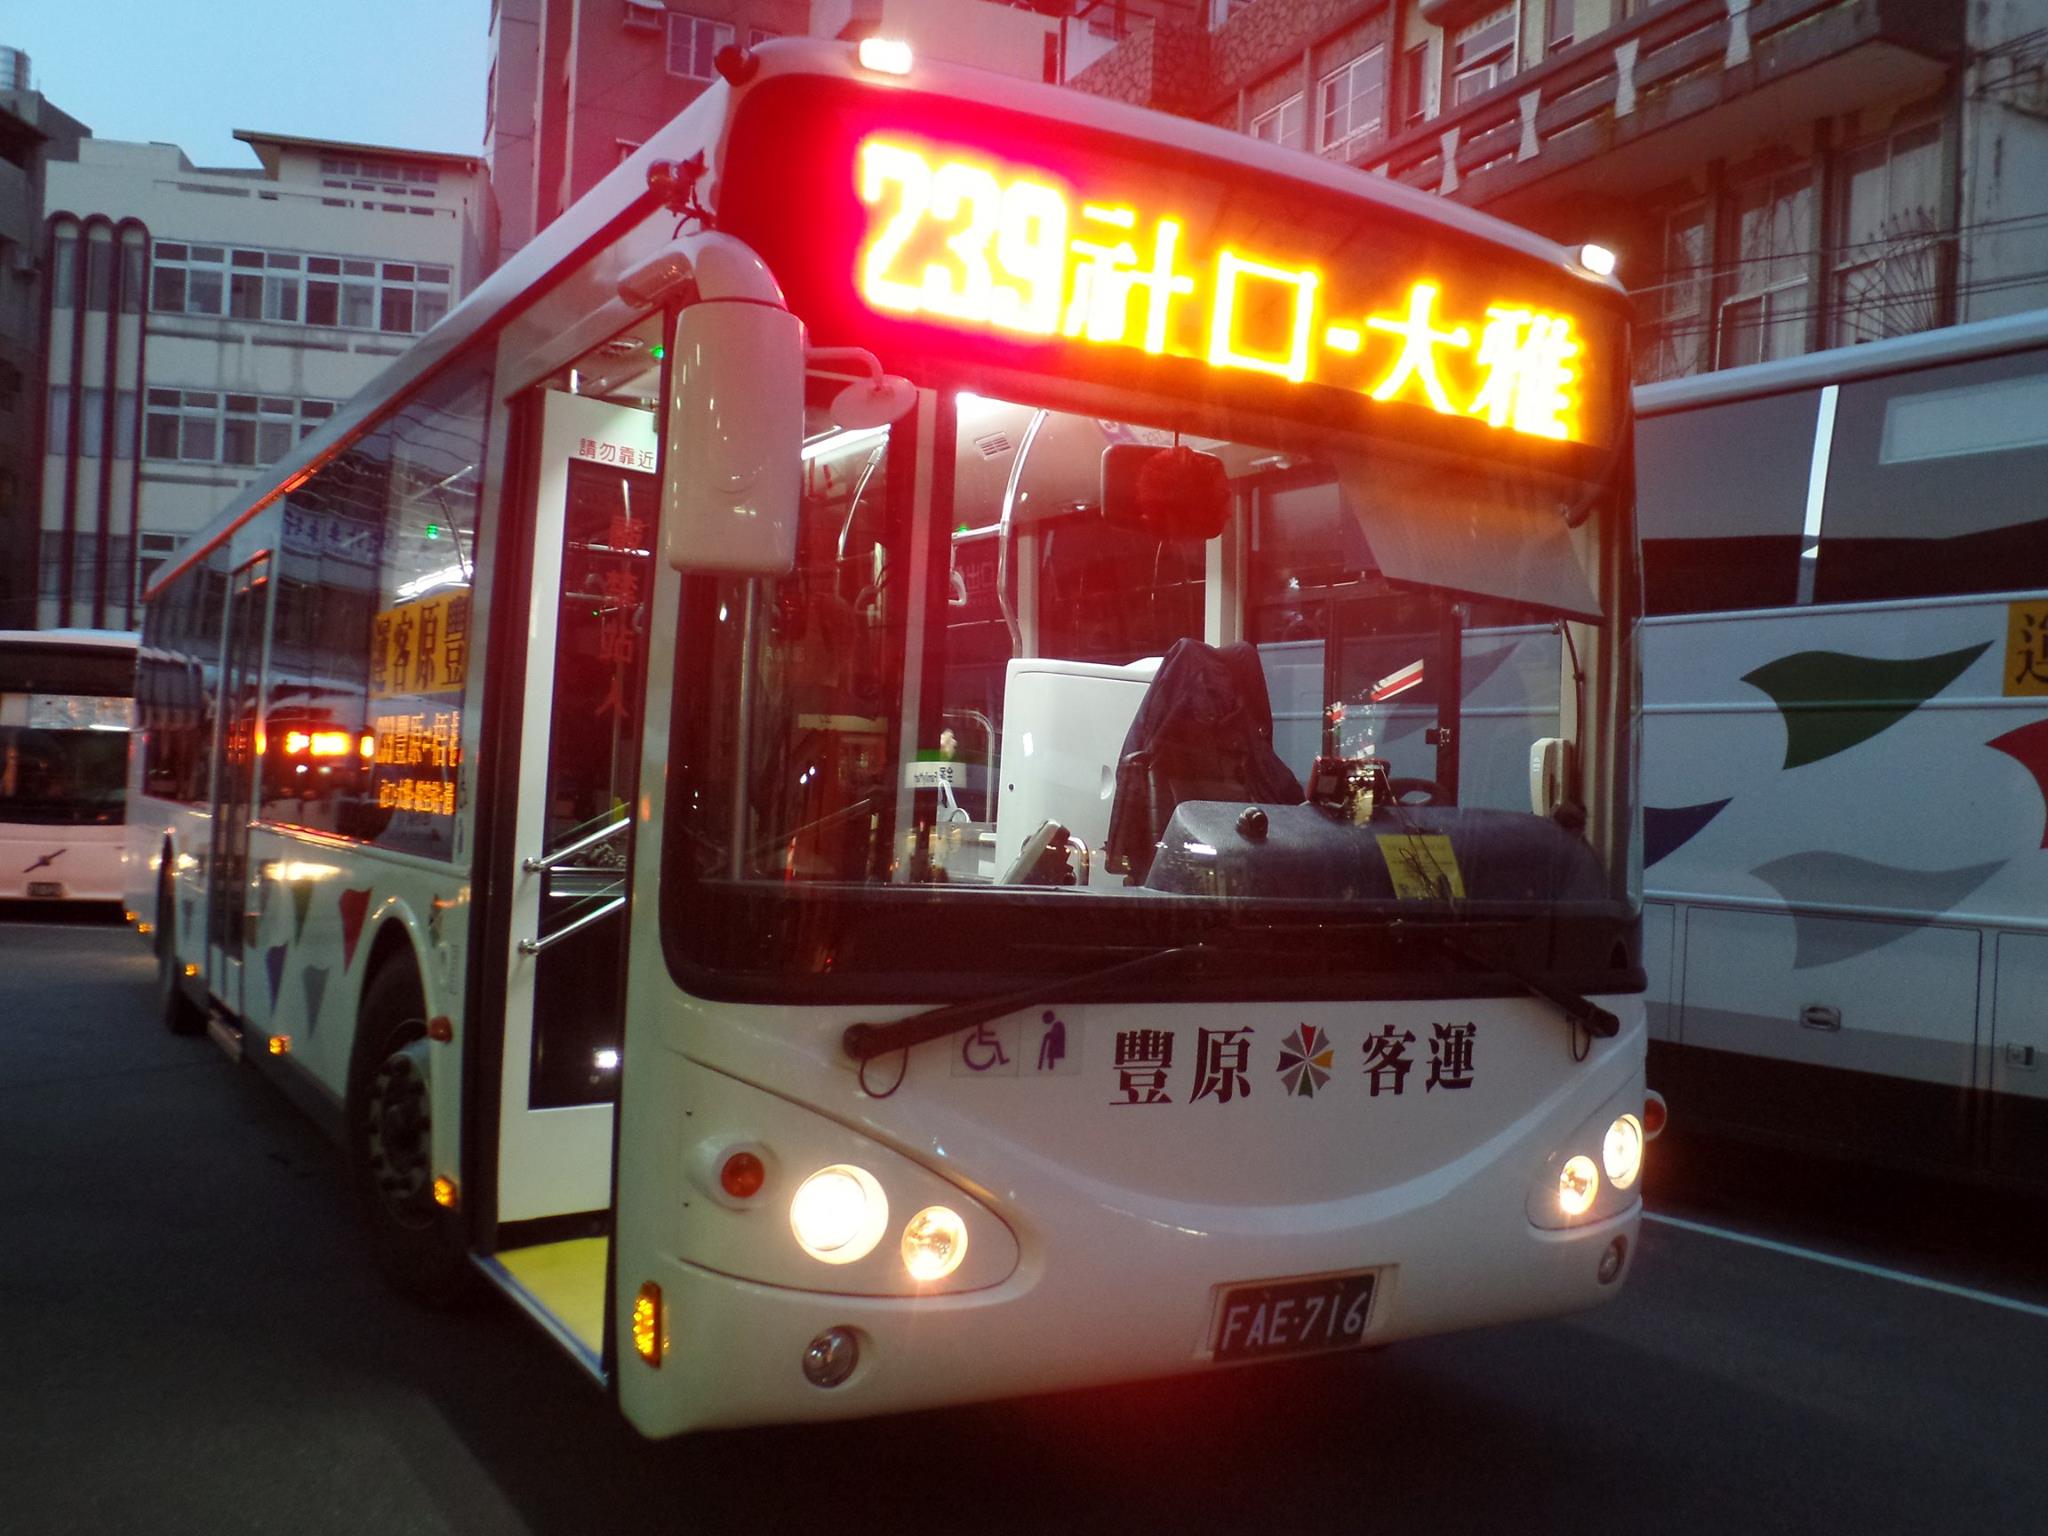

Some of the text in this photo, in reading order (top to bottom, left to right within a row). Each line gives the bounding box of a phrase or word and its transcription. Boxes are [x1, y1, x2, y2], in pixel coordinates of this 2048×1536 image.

[860, 138, 1066, 335] 239
[579, 437, 655, 470] 請勿靠近
[1109, 1020, 1478, 1105] 豐原 客運
